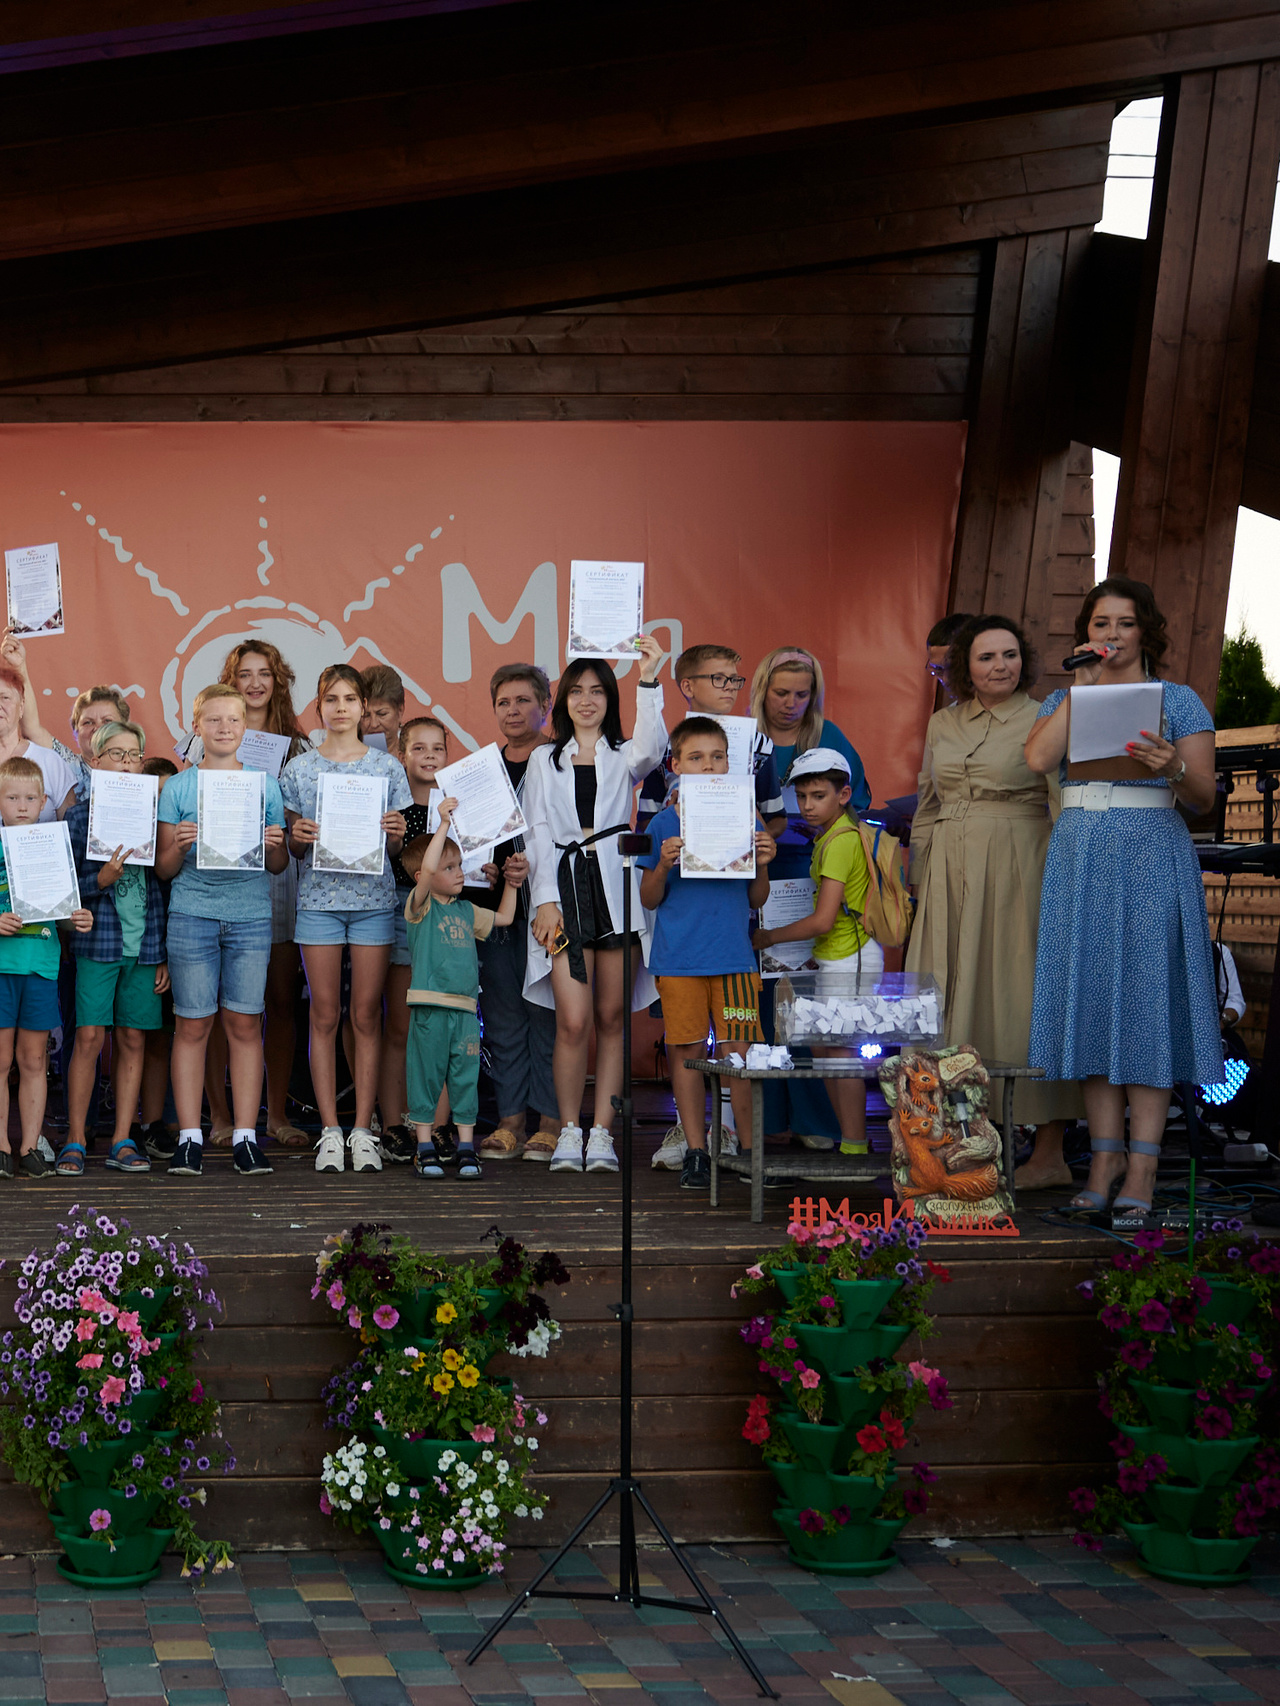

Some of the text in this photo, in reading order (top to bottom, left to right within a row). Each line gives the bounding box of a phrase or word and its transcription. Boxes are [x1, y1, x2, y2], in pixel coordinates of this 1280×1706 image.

[440, 562, 684, 684] Мя
[243, 737, 278, 748] ЕРТИФИКАТ
[770, 888, 810, 896] СЕРТИФИКАТ
[723, 1006, 758, 1022] SPORT
